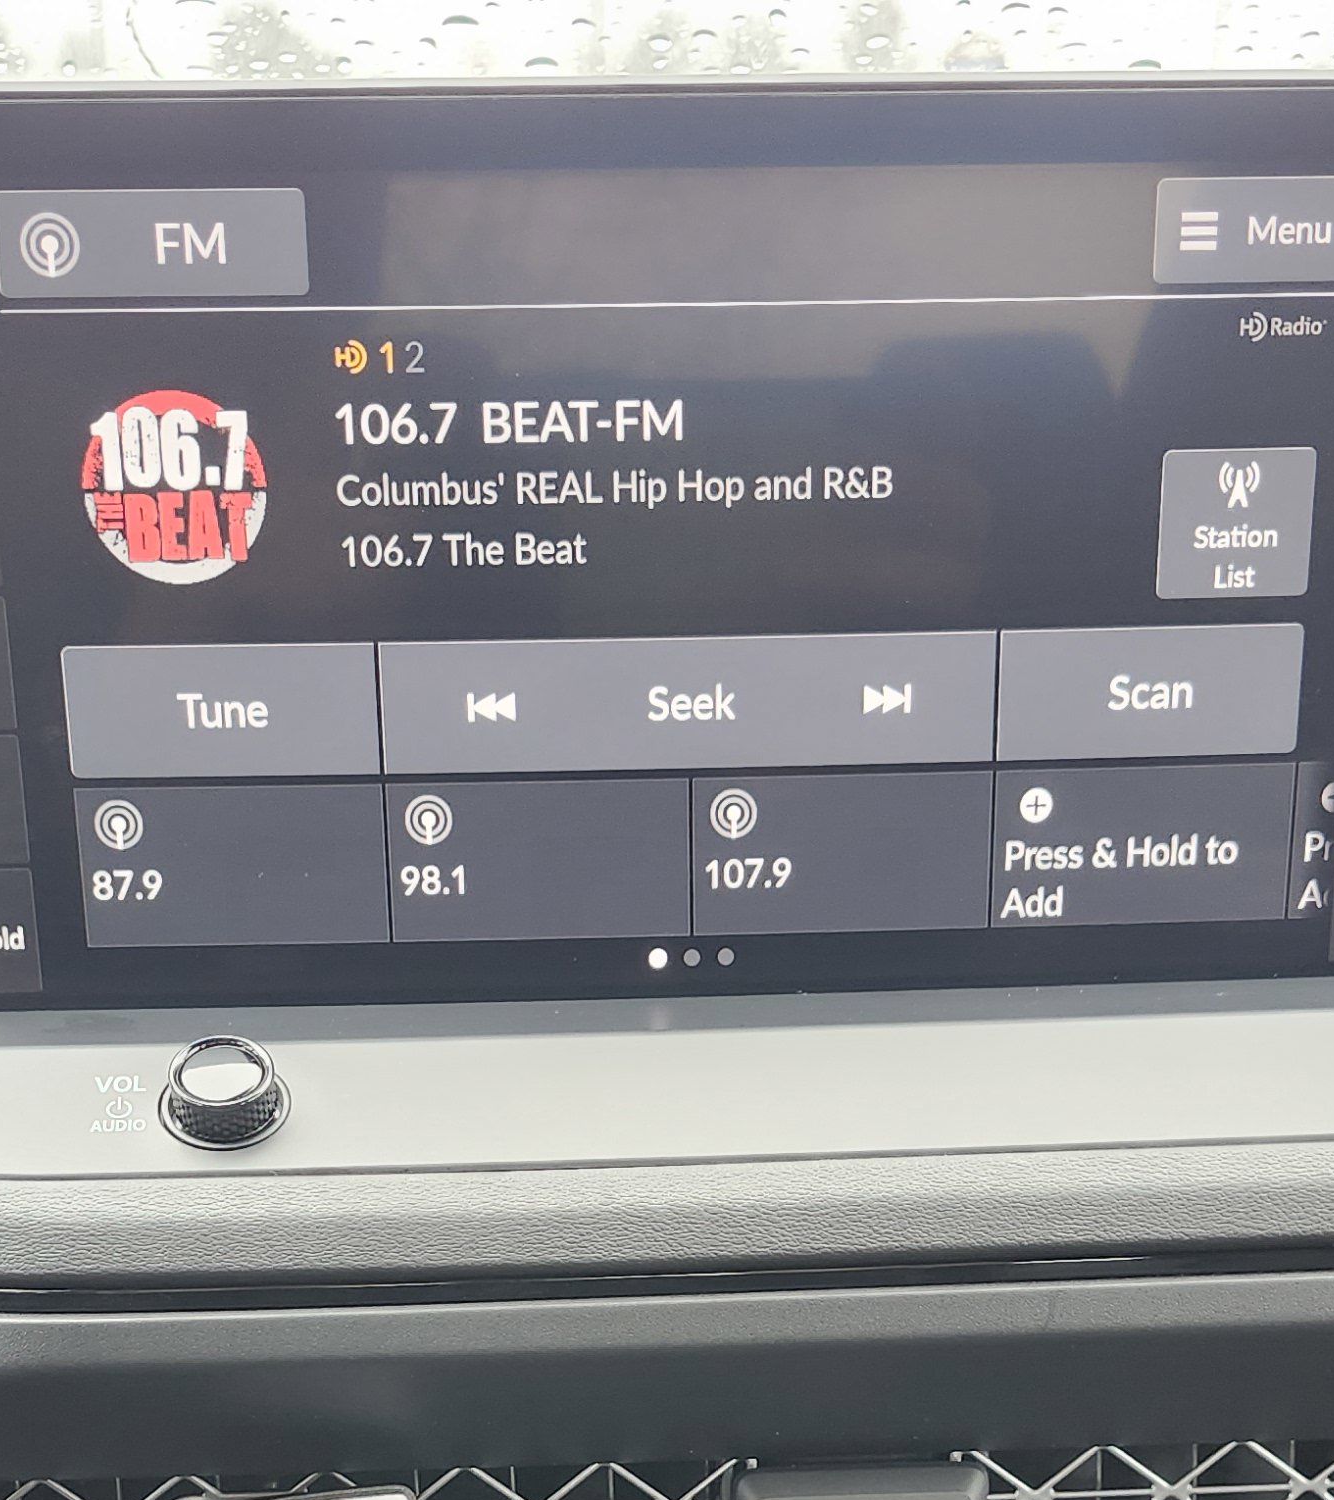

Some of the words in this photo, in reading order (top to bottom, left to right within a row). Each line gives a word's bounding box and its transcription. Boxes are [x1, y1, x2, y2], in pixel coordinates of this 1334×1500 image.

[154, 223, 227, 265] FM
[1248, 216, 1332, 245] Menu
[1270, 316, 1324, 337] Radio
[334, 403, 457, 446] 106.7
[482, 399, 684, 443] BEAT-FM
[90, 406, 248, 491] 106.7
[337, 471, 505, 507] Columbus'
[516, 471, 602, 505] REAL
[613, 469, 667, 509] Hip
[677, 468, 745, 508] Hop
[753, 466, 812, 500] and
[823, 466, 893, 500] R&B
[93, 491, 124, 533] THE
[123, 490, 253, 562] BEAT
[341, 534, 432, 568] 106.7
[443, 533, 504, 566] The
[515, 531, 587, 565] Beat
[1193, 525, 1278, 549] Station
[1214, 565, 1256, 589] List
[177, 692, 269, 730] Tune
[648, 683, 736, 722] Seek
[1107, 674, 1193, 711] Scan
[1004, 839, 1083, 871] Press
[1092, 836, 1117, 869] &
[1127, 833, 1197, 868] Hold
[1205, 834, 1239, 866] to
[92, 869, 163, 901] 87.9
[400, 864, 465, 896] 98.1
[705, 857, 792, 891] 107.9
[1000, 885, 1064, 920] Add
[94, 1075, 147, 1093] VOL
[90, 1118, 147, 1133] AUDIO
